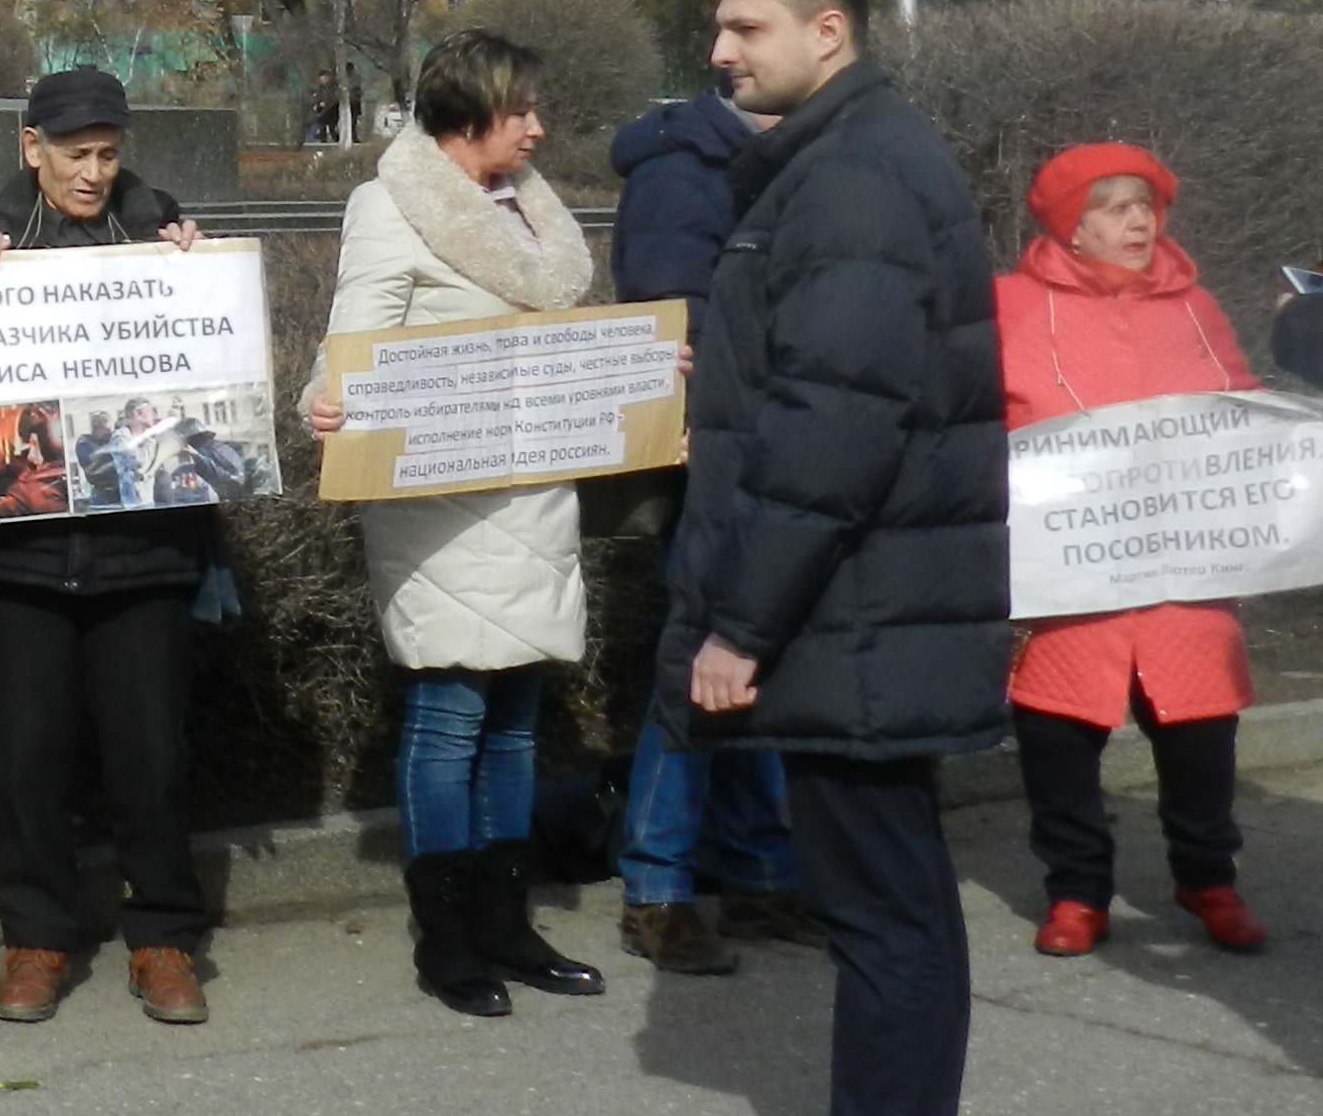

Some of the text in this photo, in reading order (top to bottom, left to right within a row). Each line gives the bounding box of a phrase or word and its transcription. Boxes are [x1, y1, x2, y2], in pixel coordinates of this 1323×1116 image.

[42, 278, 174, 305] НАКАЗАТЬ
[101, 315, 235, 342] УБИЙСТВА
[378, 345, 449, 366] Достойная
[451, 339, 492, 357] жизнь,
[496, 332, 529, 352] прва
[532, 334, 542, 346] и
[543, 326, 598, 348] свободы
[62, 352, 192, 380] НЕМЦОВА
[347, 375, 458, 399] справедливость,
[460, 363, 540, 385] независимые
[542, 363, 576, 380] суды,
[579, 354, 630, 372] честные
[346, 407, 411, 424] контроль
[413, 400, 500, 418] избирателями
[502, 396, 521, 411] нд
[525, 391, 567, 409] всеми
[567, 383, 626, 406] уровнями
[408, 426, 483, 447] исполнение
[514, 415, 596, 435] Конституции
[599, 411, 615, 427] РФ
[1009, 404, 1252, 459] РИНИМАЮЩИЙ
[398, 453, 506, 479] национальная
[549, 445, 611, 466] россиян.
[1043, 478, 1295, 532] СТАНОВИТСЯ ЕГО
[1062, 523, 1290, 566] ПОСОБНИКОМ.
